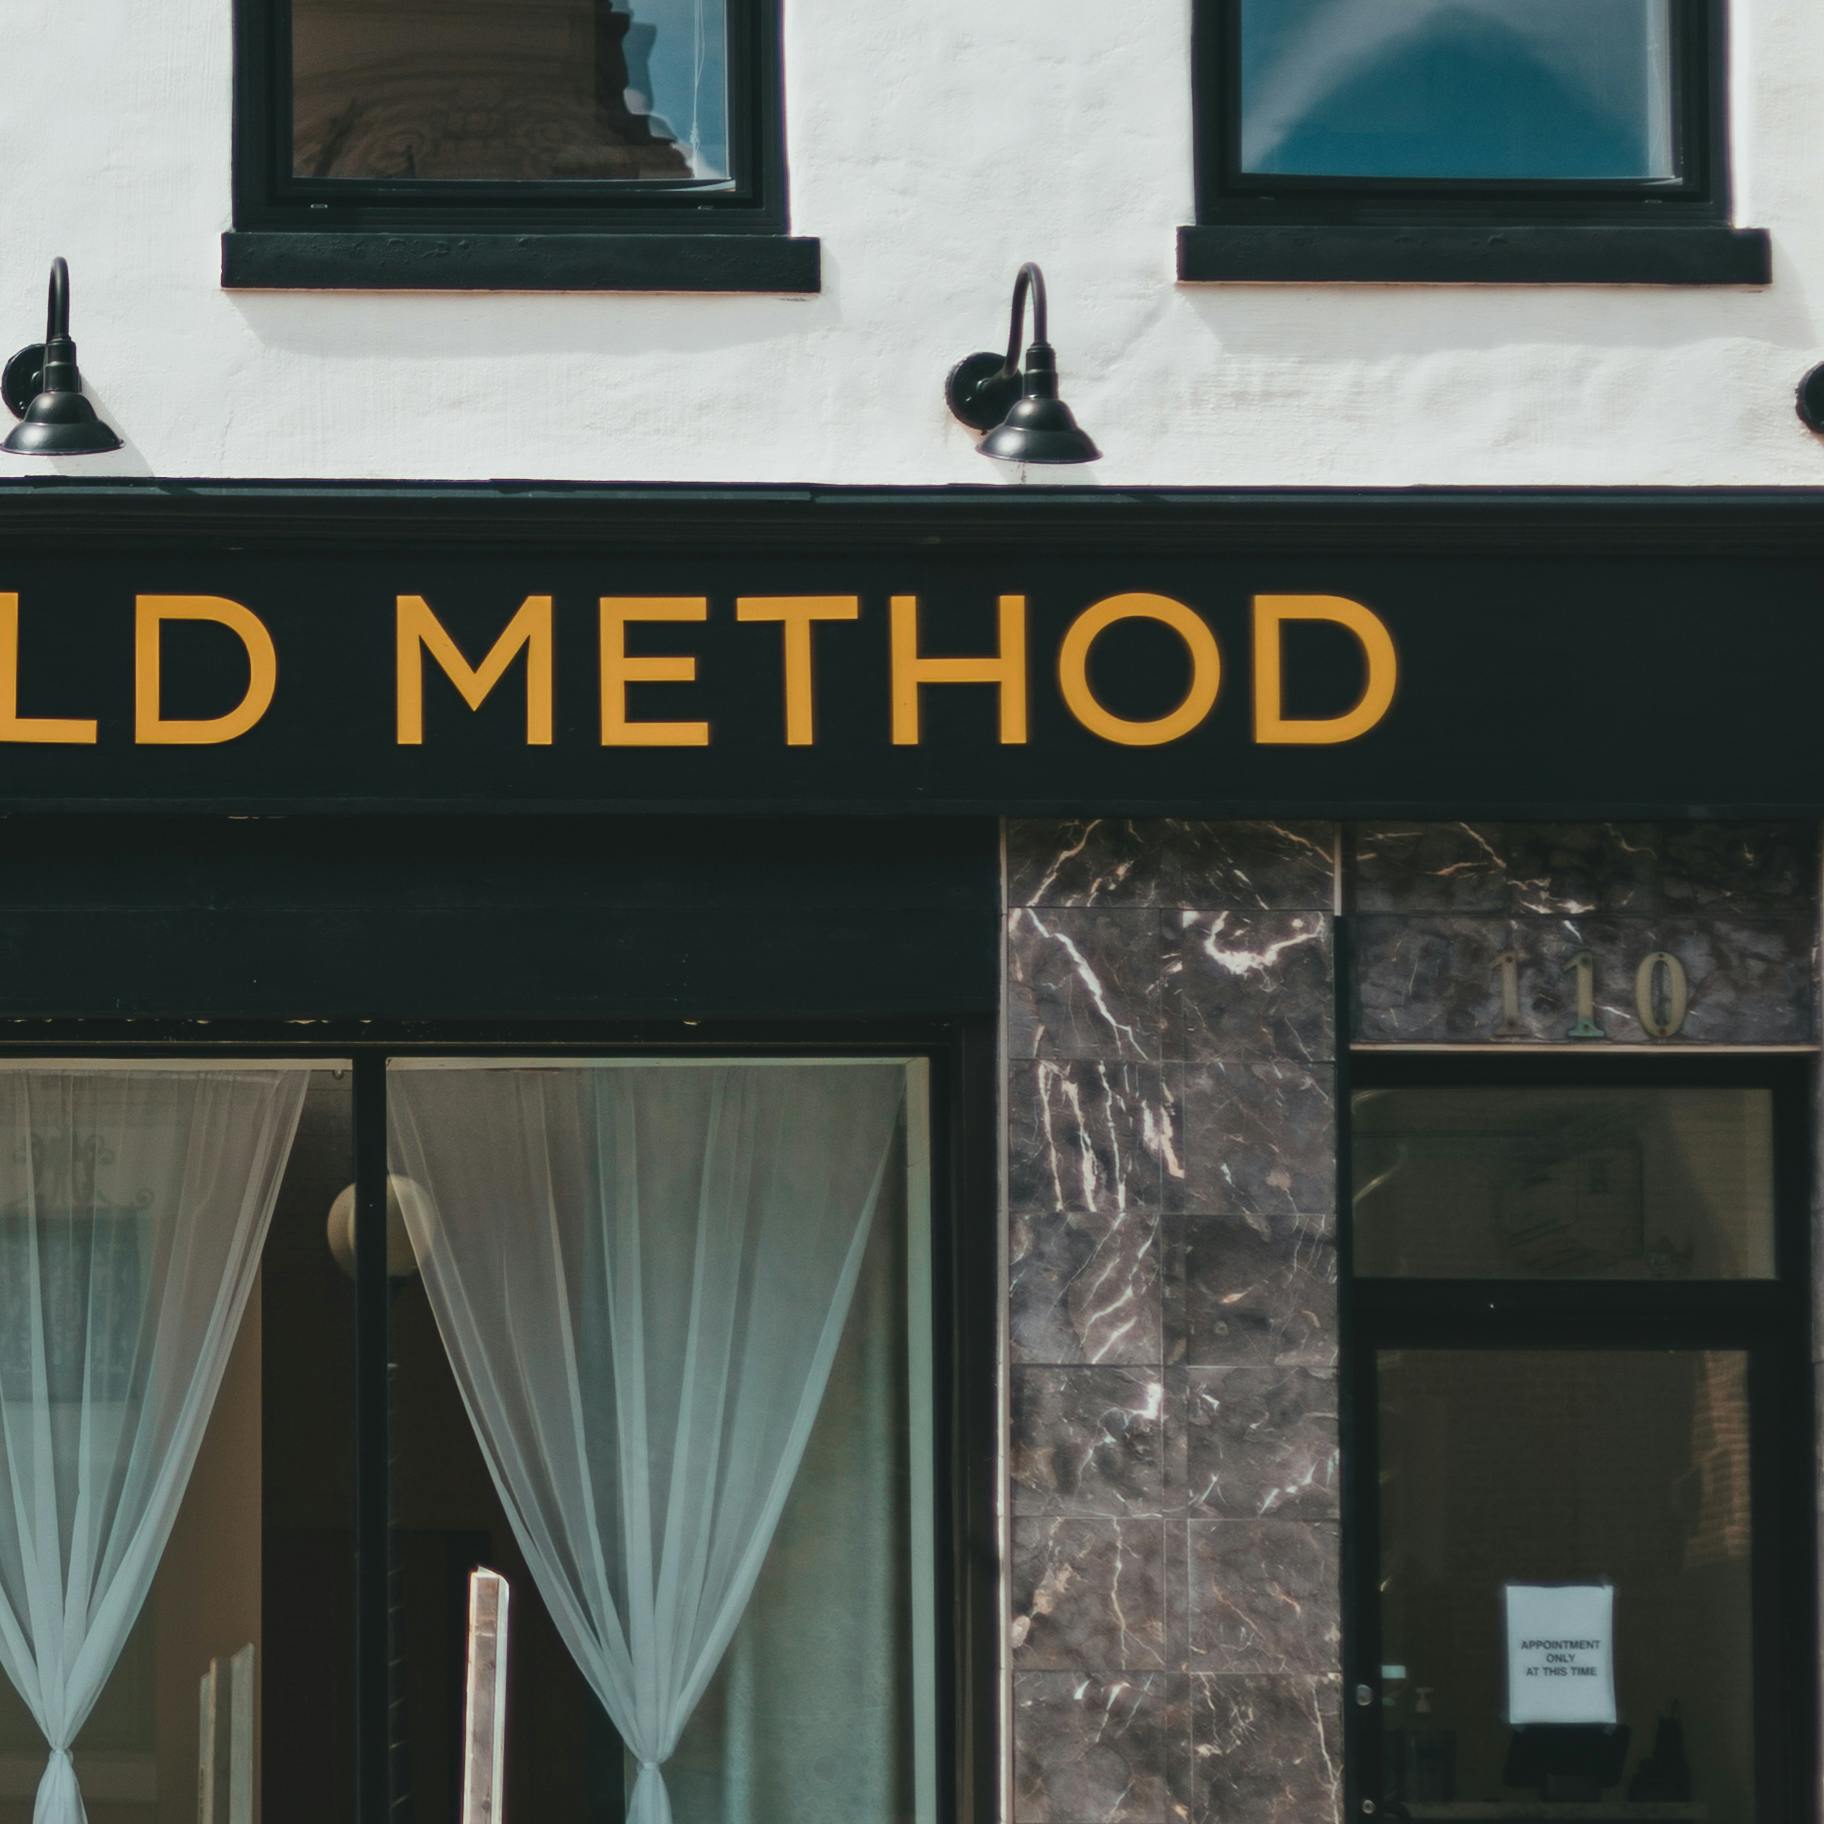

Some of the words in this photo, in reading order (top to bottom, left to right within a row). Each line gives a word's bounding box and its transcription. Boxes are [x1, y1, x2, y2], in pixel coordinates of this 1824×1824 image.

[396, 592, 1397, 747] METHOD
[1490, 951, 1687, 1038] 110
[1521, 1640, 1601, 1650] APPOINTMENT
[1546, 1653, 1576, 1663] ONLY
[1526, 1667, 1539, 1676] AT
[1543, 1667, 1568, 1676] THIS
[1571, 1667, 1598, 1676] TIME
